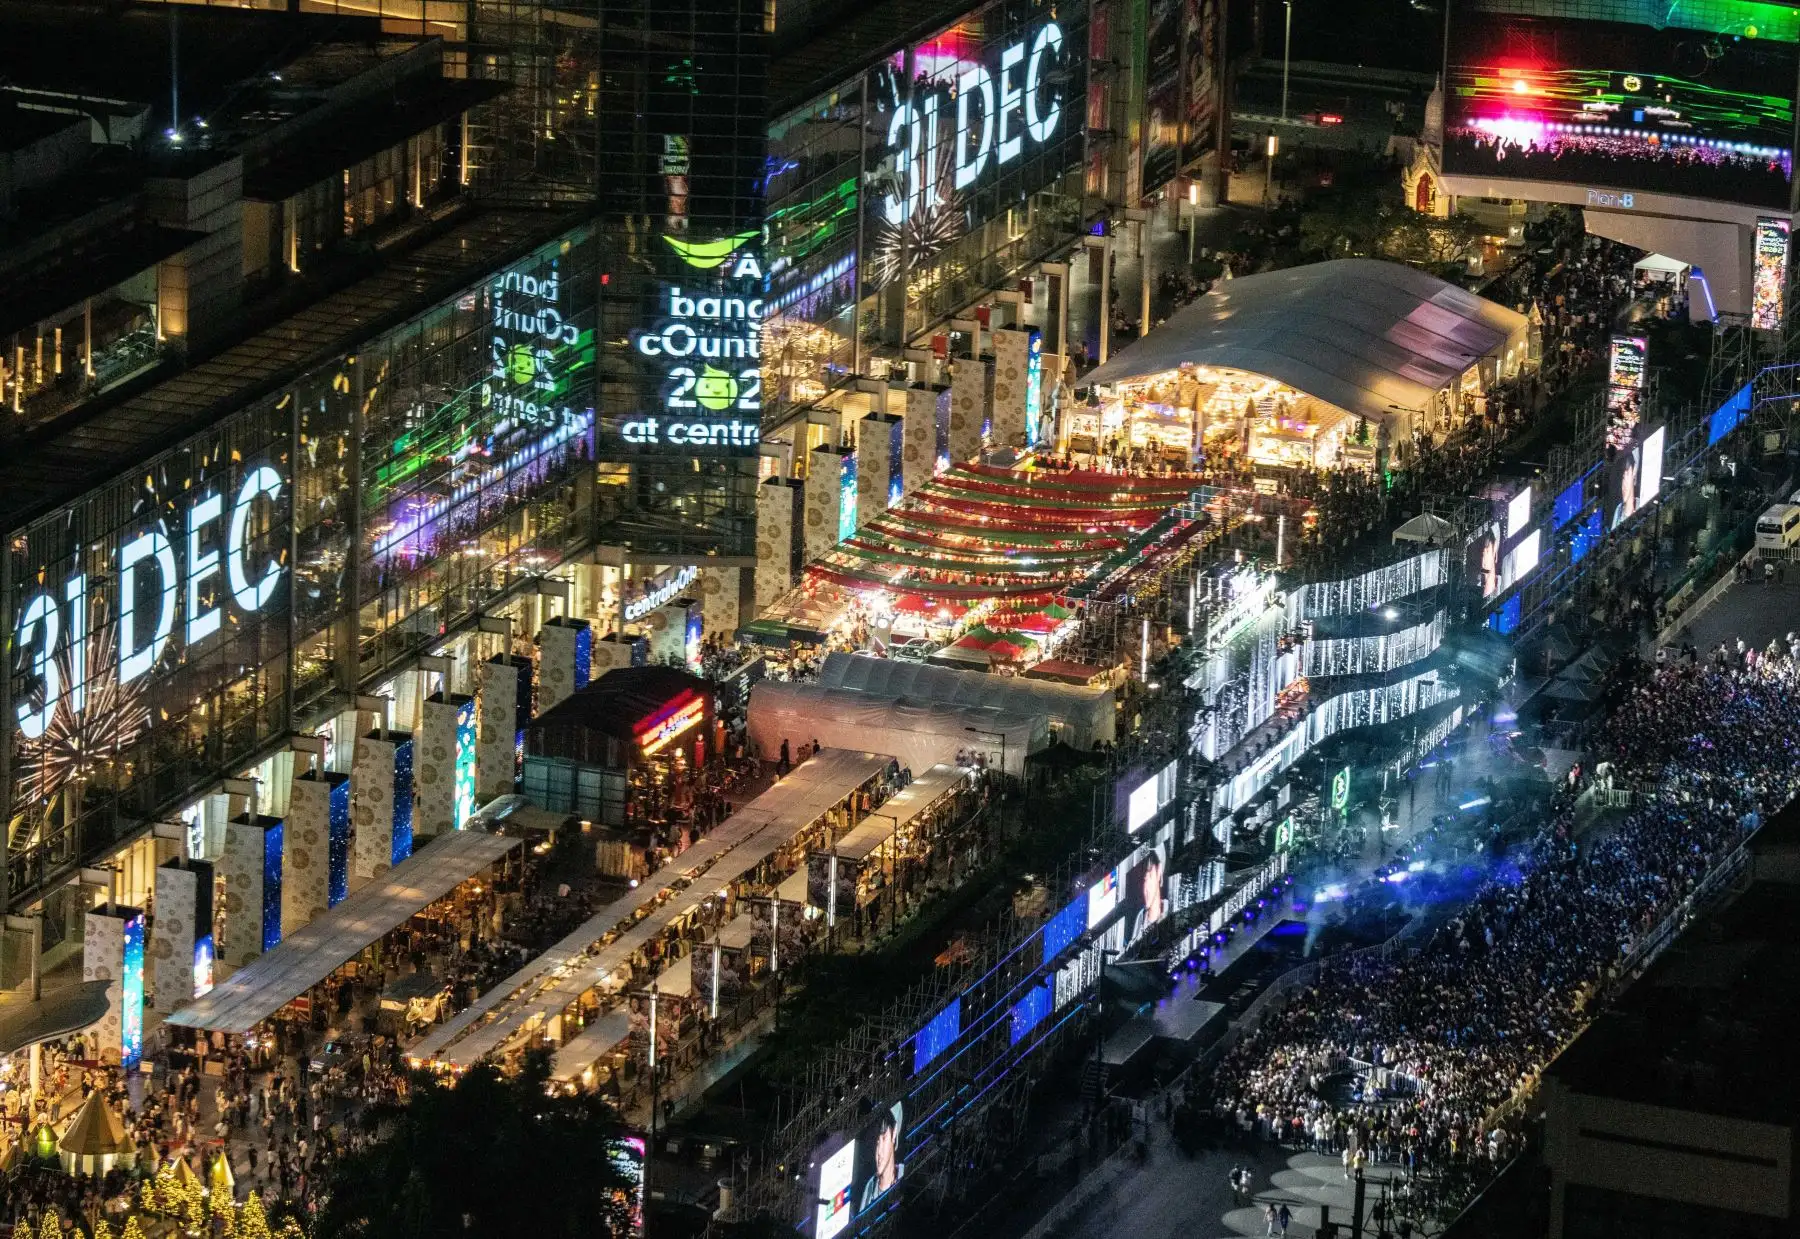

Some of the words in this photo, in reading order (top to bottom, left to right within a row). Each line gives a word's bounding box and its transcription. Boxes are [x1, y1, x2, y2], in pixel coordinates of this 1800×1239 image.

[886, 94, 938, 224] 31
[955, 23, 1062, 190] DEC
[621, 417, 659, 444] at
[17, 573, 87, 739] 31
[120, 466, 283, 686] DEC
